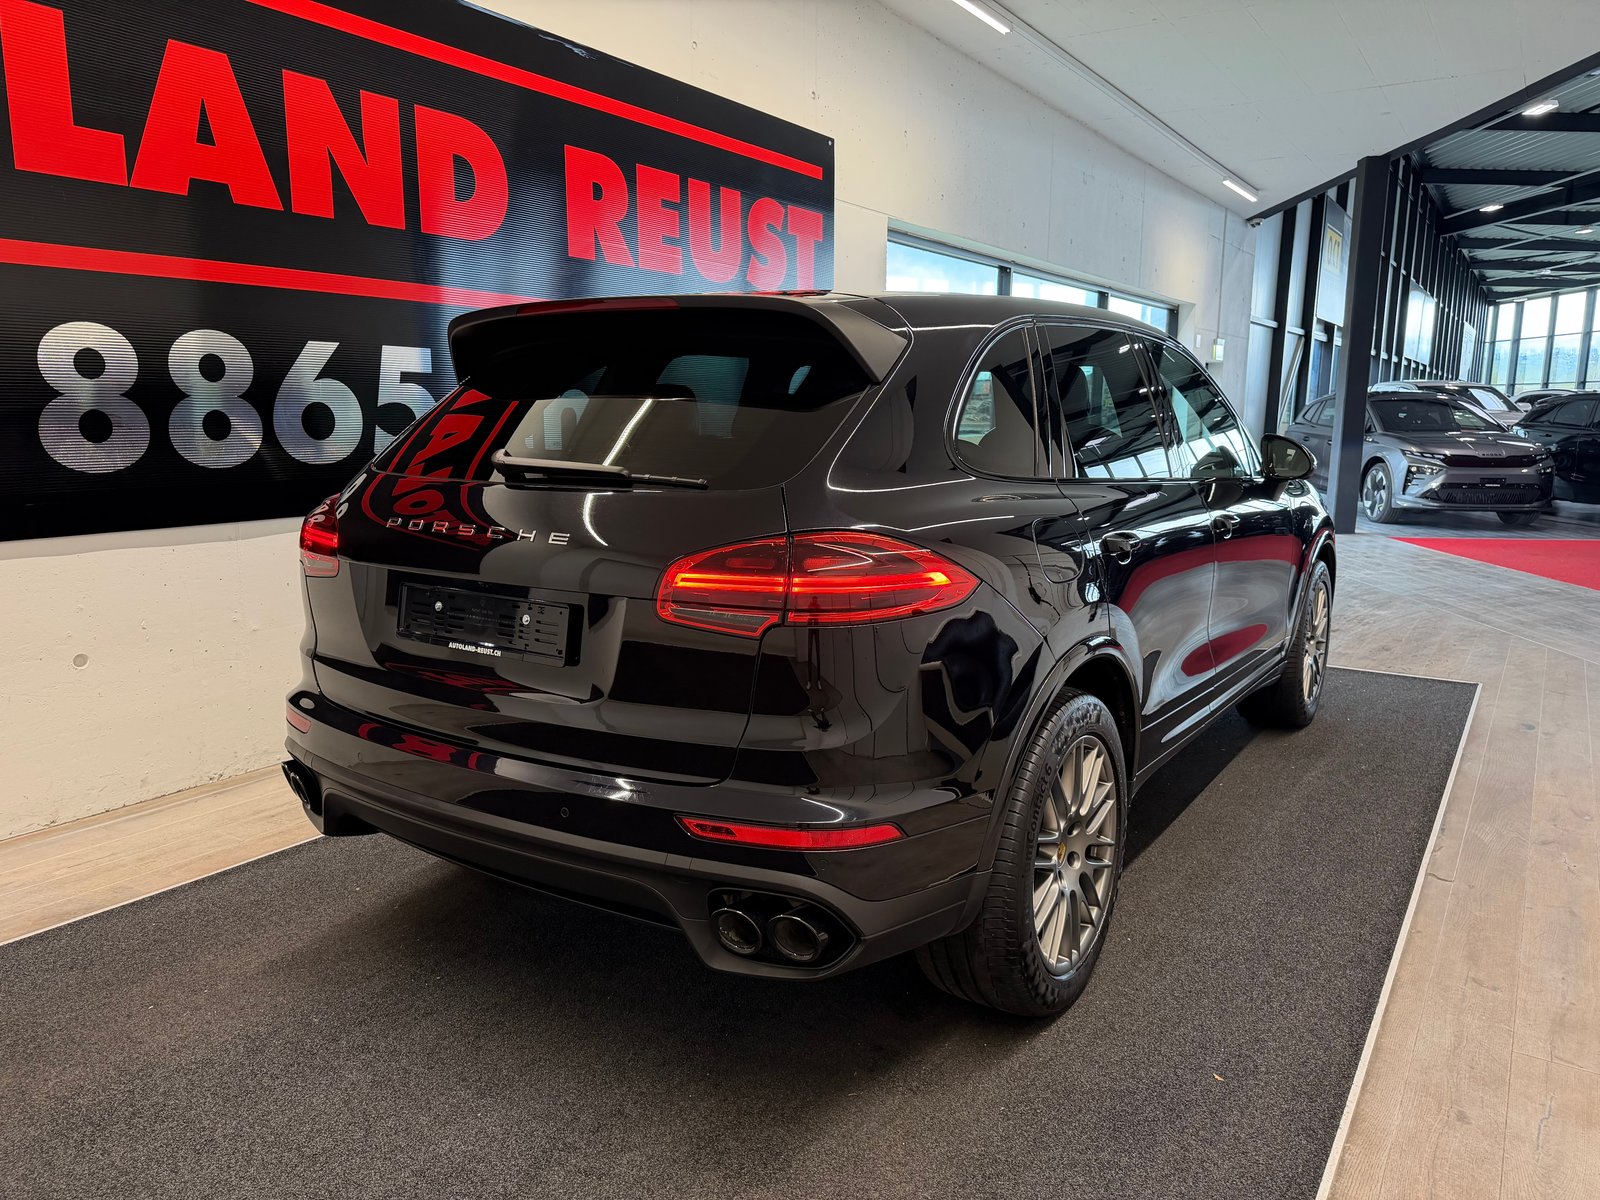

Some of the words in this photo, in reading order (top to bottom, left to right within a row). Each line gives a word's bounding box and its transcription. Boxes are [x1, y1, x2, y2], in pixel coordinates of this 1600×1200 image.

[0, 0, 509, 241] LAND
[564, 143, 823, 291] REUST
[37, 321, 437, 474] 8865
[386, 516, 571, 546] PORSCHE
[448, 641, 502, 657] AUTOLAND-REUST.CH
